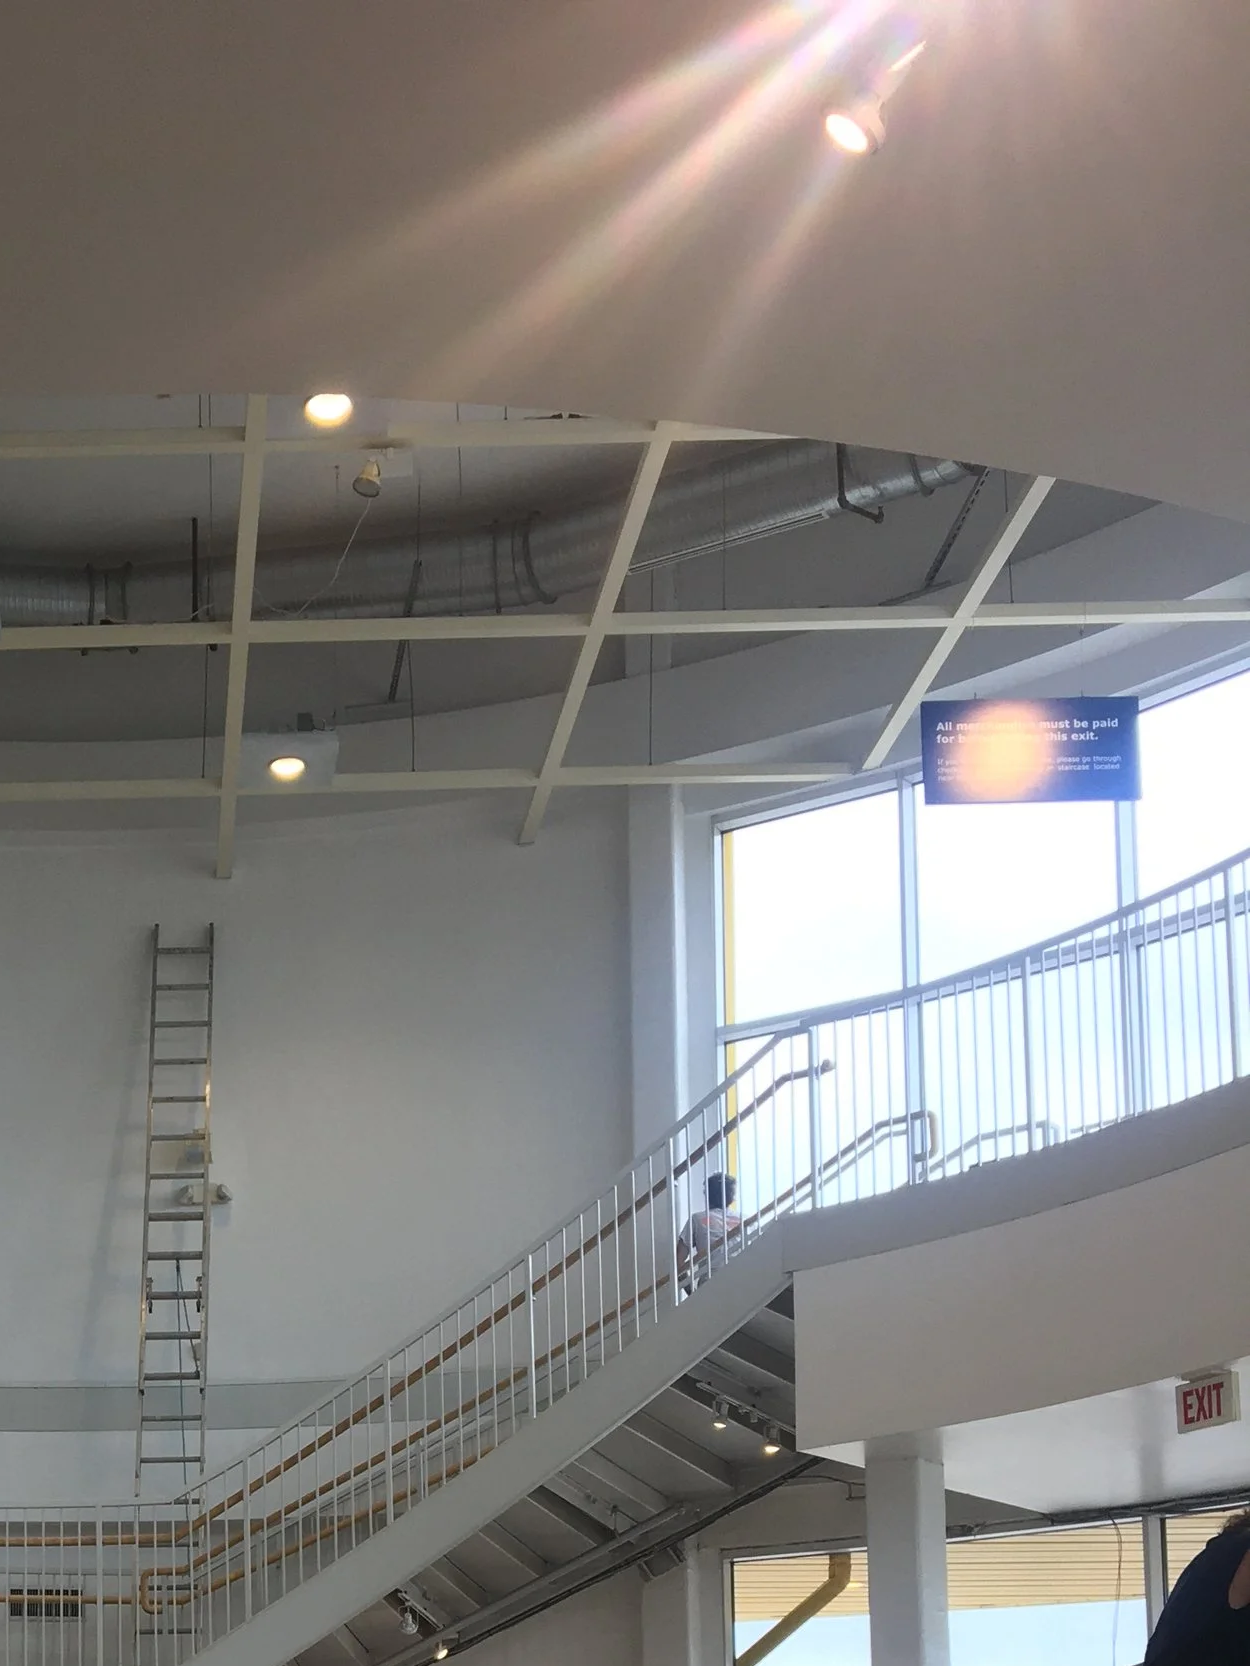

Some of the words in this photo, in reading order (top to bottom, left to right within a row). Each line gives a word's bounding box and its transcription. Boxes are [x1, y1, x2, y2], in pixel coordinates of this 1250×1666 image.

[936, 721, 953, 731] All
[1039, 719, 1070, 729] must
[1073, 719, 1089, 728] be
[1092, 718, 1119, 730] paid
[936, 734, 955, 744] for
[1045, 731, 1068, 741] this
[1070, 731, 1099, 741] exit.
[1056, 756, 1080, 764] please
[1082, 756, 1091, 764] go
[1093, 755, 1122, 763] through
[1093, 763, 1120, 771] located
[1182, 1381, 1224, 1425] EXIT
